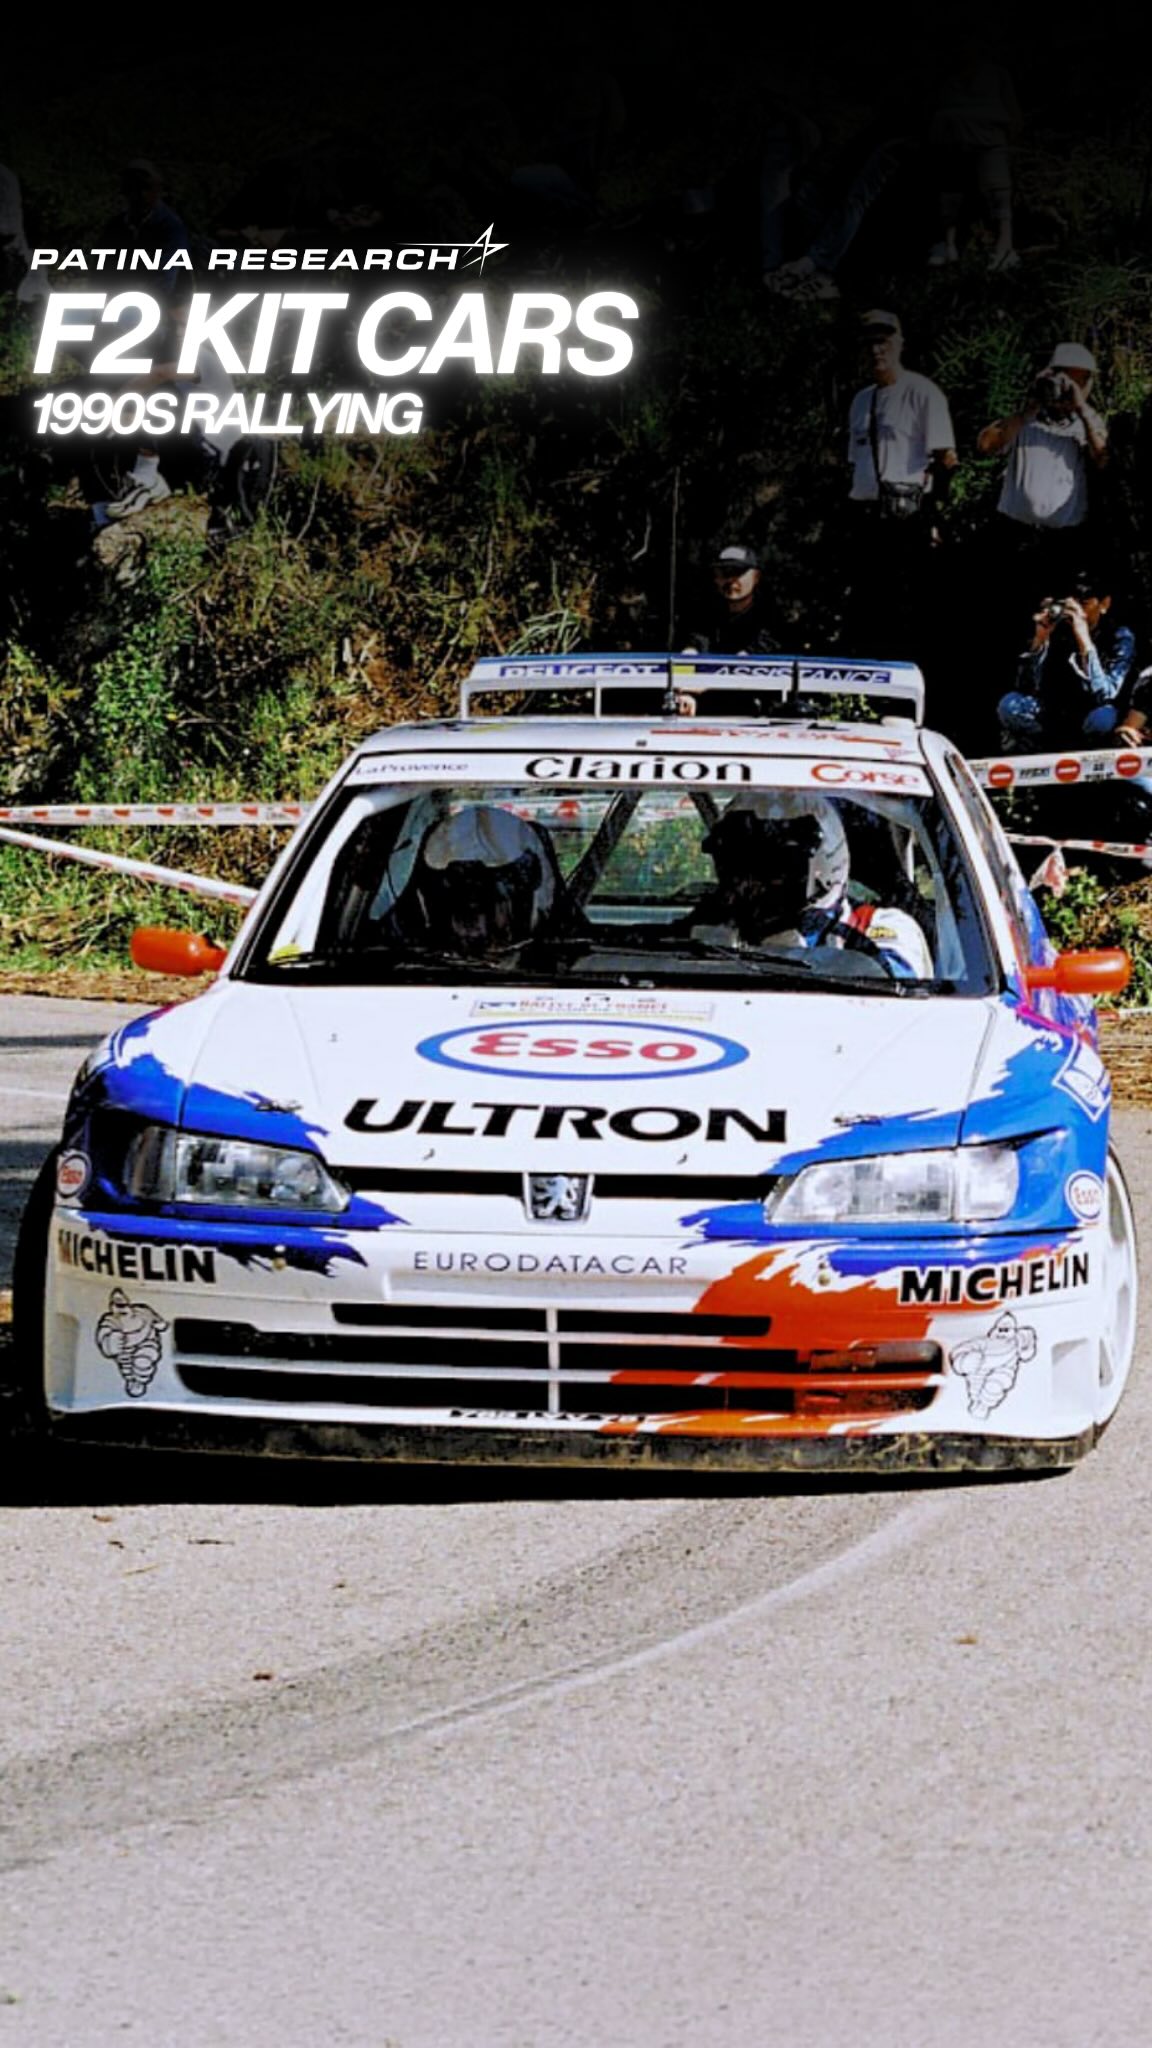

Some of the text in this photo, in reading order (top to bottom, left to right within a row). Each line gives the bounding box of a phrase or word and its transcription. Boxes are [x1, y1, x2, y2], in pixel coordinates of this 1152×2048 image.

[504, 664, 890, 683] PEUGEOT ASSISTANCE
[525, 755, 752, 782] Clarion
[810, 762, 919, 786] Corse
[343, 1098, 788, 1143] ULTRON
[57, 1228, 217, 1284] MICHELIN
[413, 1251, 689, 1275] EURODATACAR
[899, 1251, 1090, 1303] MICHELIN
